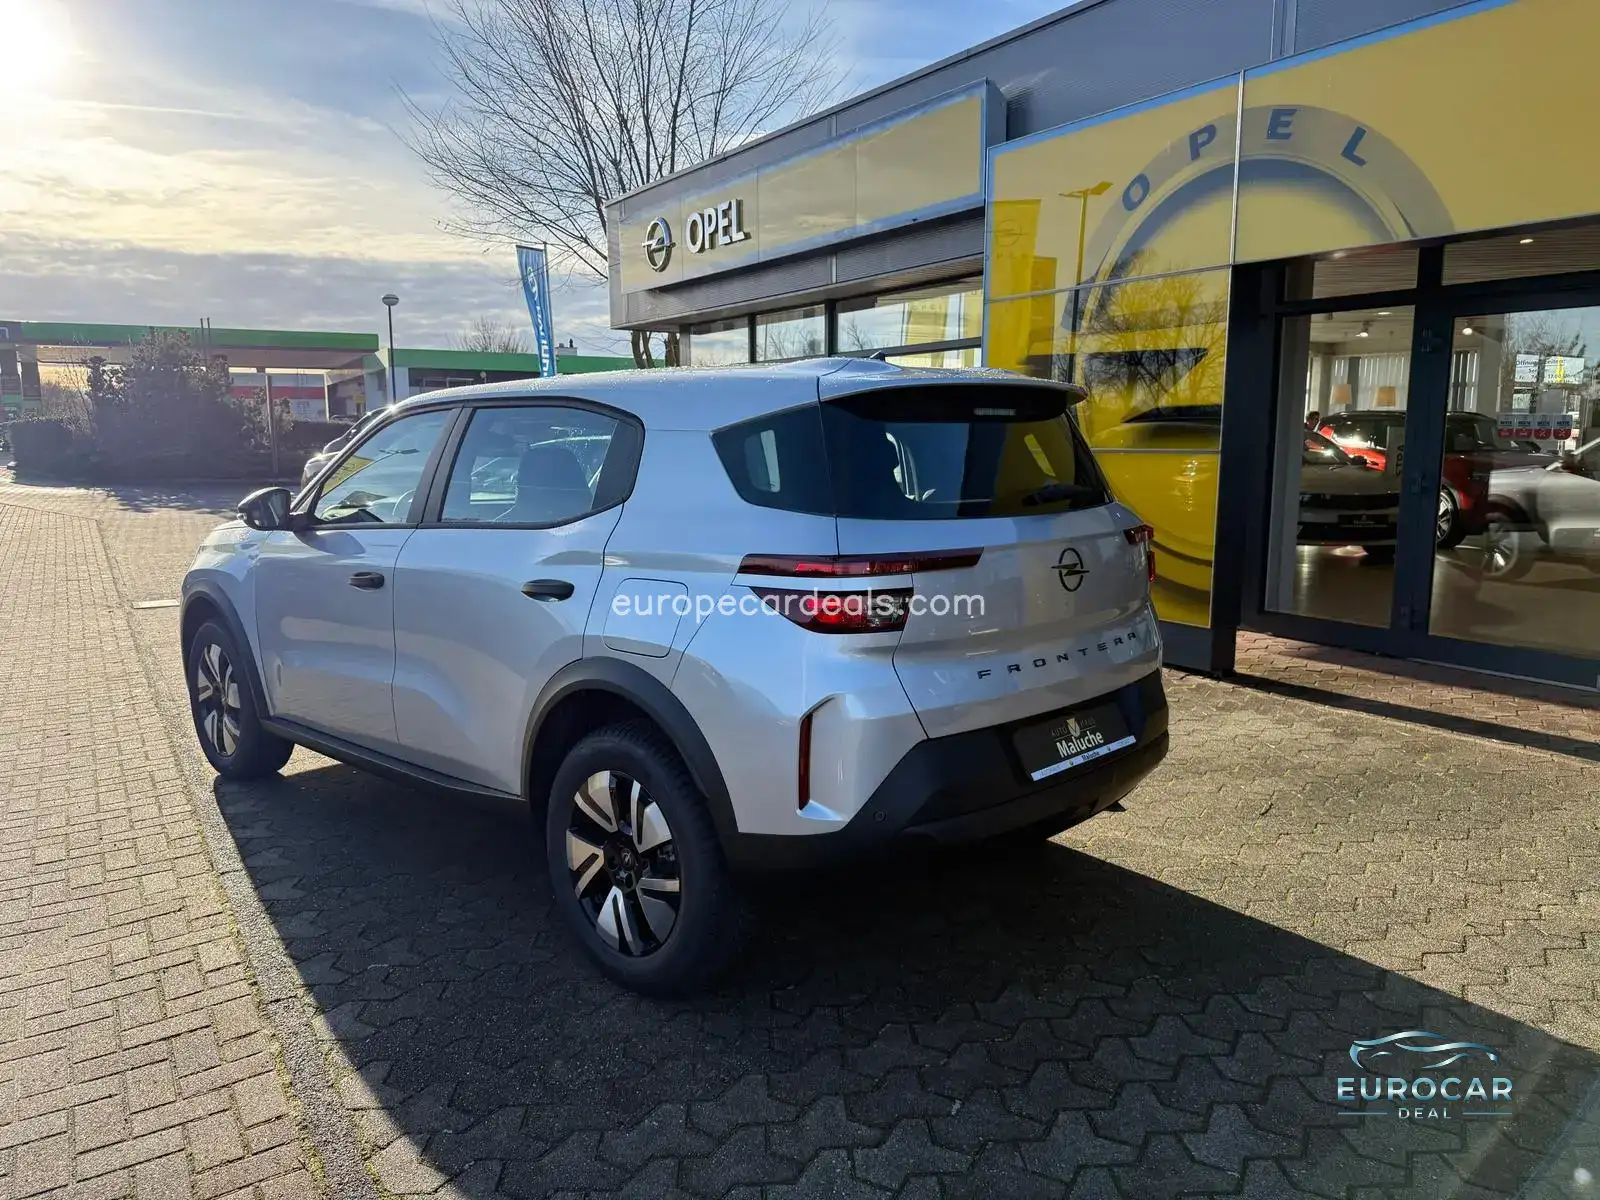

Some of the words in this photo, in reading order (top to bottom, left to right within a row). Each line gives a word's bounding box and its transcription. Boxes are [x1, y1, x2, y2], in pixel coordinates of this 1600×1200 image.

[1122, 107, 1369, 212] OPEL
[685, 198, 750, 254] OPEL
[976, 631, 1137, 680] FRONTERA
[1055, 730, 1105, 758] Maluche
